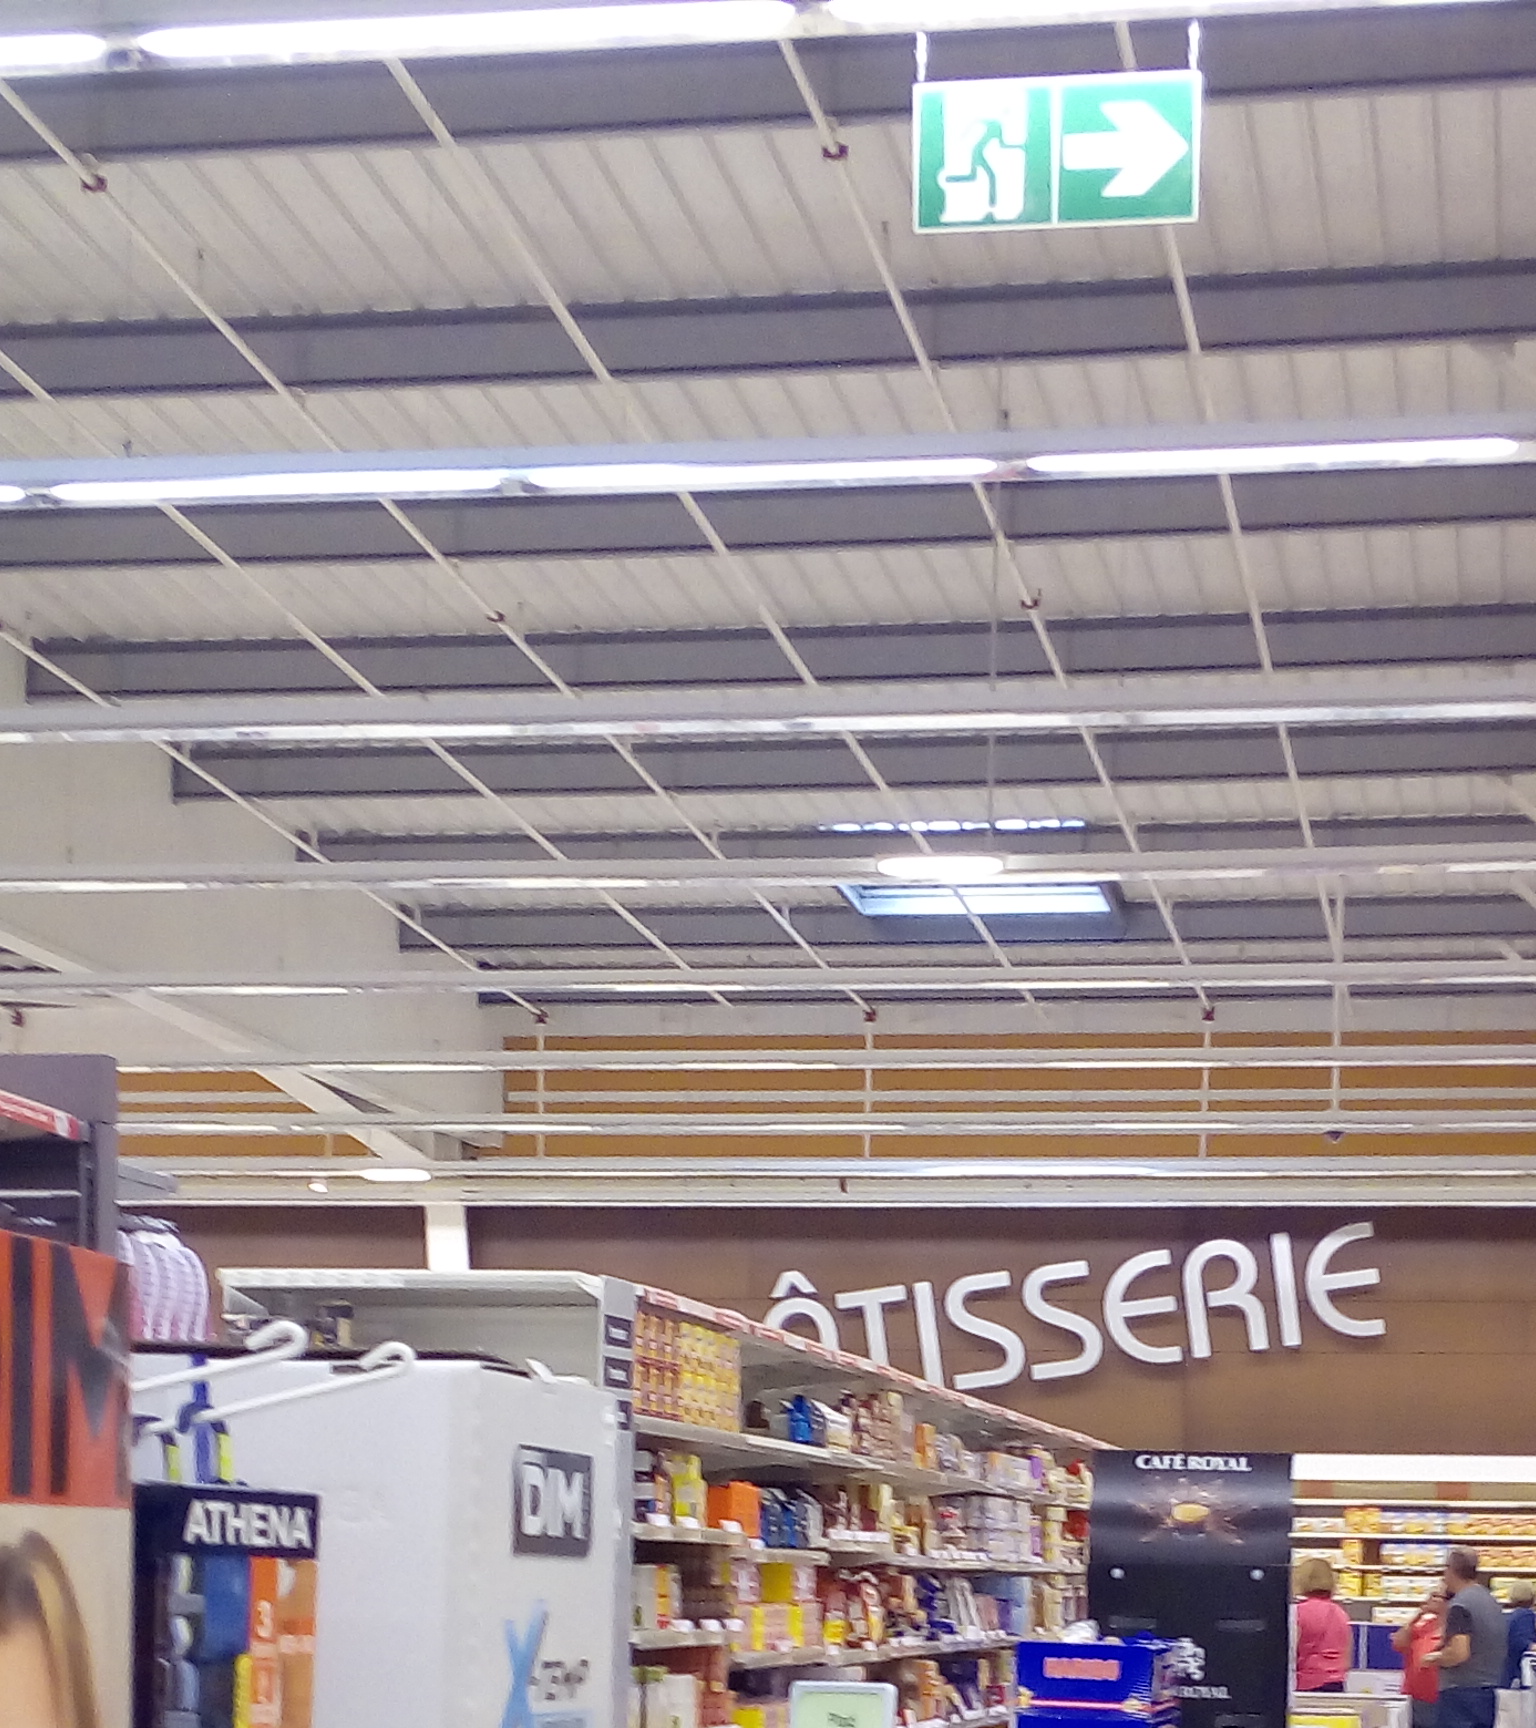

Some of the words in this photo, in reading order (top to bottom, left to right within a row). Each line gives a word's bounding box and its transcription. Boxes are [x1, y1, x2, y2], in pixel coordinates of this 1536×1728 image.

[1134, 1452, 1186, 1471] CAFÉ
[1187, 1455, 1253, 1472] ROYAL
[182, 1498, 315, 1548] ATHENA
[520, 1460, 588, 1540] DIM
